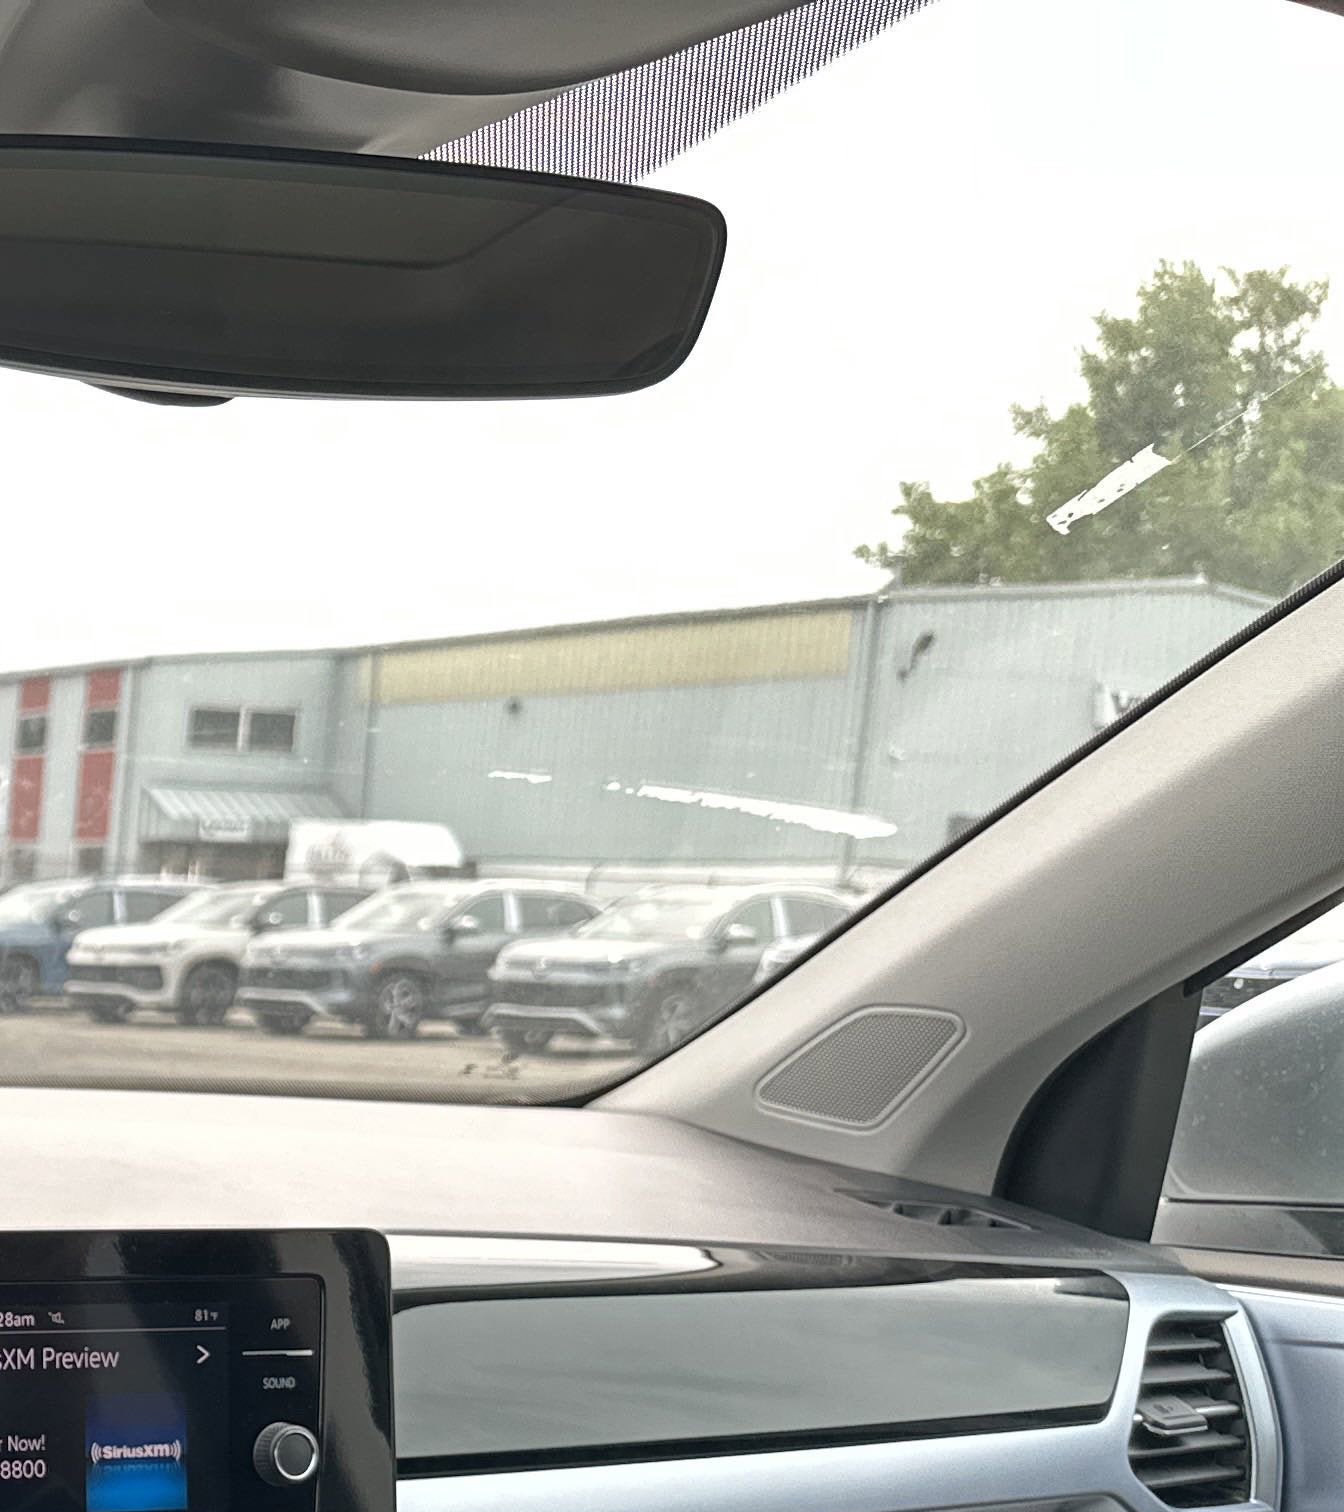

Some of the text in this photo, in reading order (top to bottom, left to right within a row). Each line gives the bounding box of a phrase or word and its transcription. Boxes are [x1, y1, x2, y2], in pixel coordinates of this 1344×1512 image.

[270, 1317, 291, 1331] APP
[42, 1346, 121, 1371] Preview
[261, 1376, 296, 1390] SOUND
[7, 1434, 47, 1453] Now!
